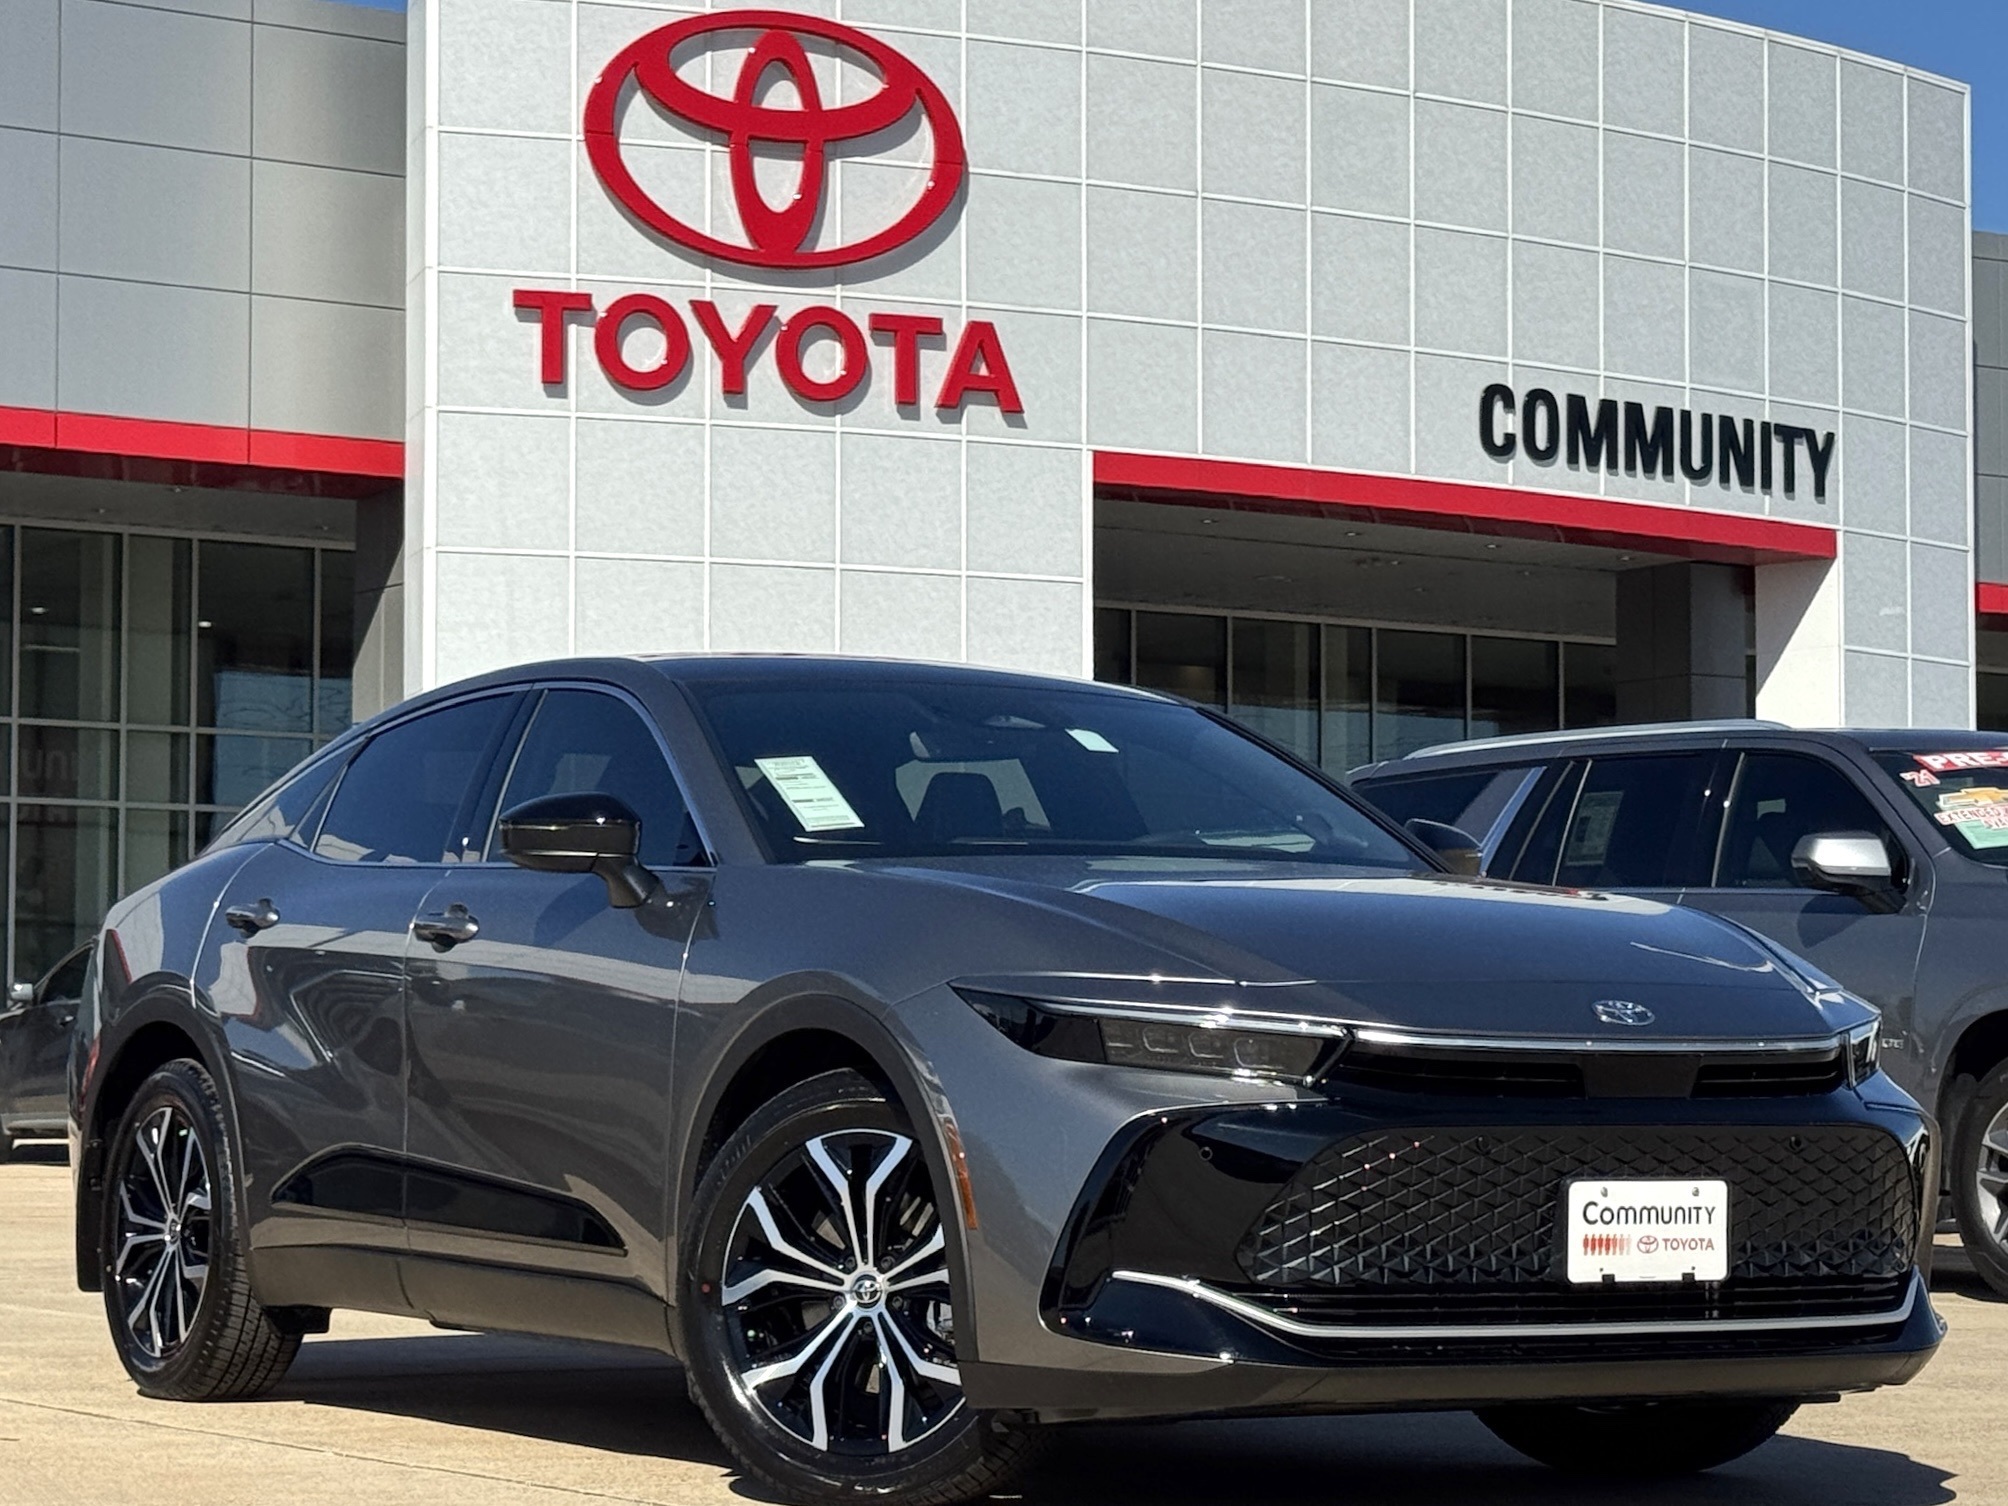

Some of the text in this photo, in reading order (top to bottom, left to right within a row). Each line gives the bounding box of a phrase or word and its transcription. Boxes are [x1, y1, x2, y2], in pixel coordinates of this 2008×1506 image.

[513, 289, 1024, 414] TOYOTA
[1479, 383, 1835, 498] COMMUNITY
[1662, 1237, 1715, 1251] TOYOTA
